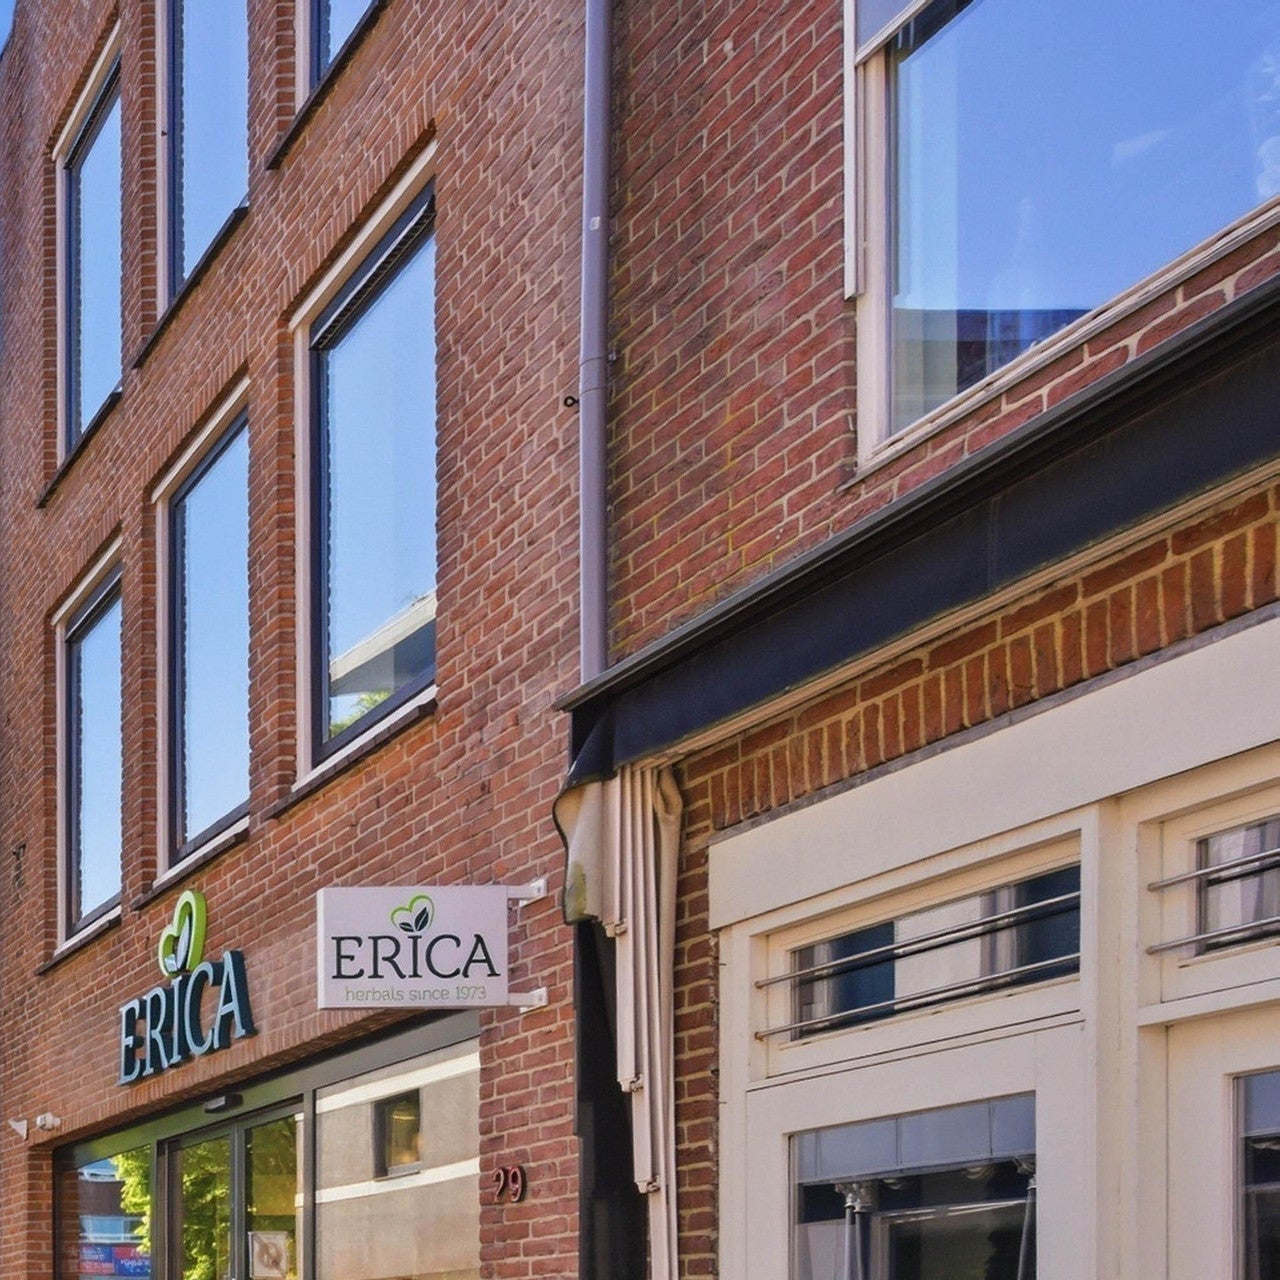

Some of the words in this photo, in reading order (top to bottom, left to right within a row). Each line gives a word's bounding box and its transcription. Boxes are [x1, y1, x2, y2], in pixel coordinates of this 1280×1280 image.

[331, 934, 501, 980] ERICA
[345, 986, 405, 1001] herbals
[409, 989, 450, 1001] since
[456, 986, 487, 1000] 1973
[117, 949, 257, 1086] ERICA
[493, 1167, 523, 1203] 29
